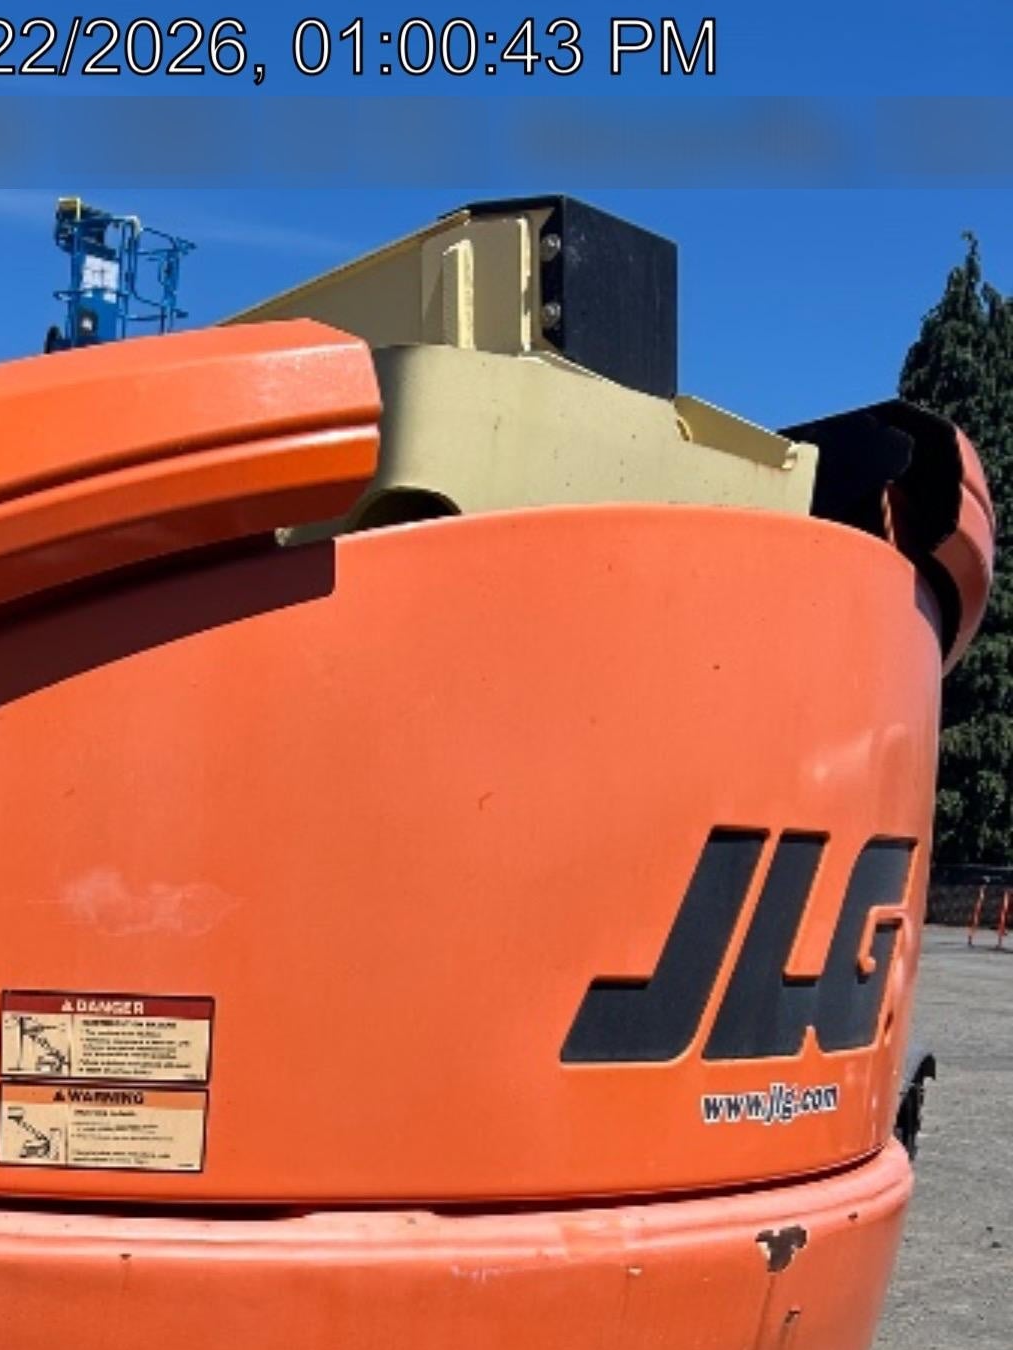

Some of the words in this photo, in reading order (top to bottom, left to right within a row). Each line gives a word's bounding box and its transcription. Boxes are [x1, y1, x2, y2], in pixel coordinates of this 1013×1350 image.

[561, 826, 918, 1062] JLG
[77, 1000, 144, 1015] DANGER
[67, 1090, 144, 1105] WARNING
[702, 1083, 838, 1124] www.jlg.com
